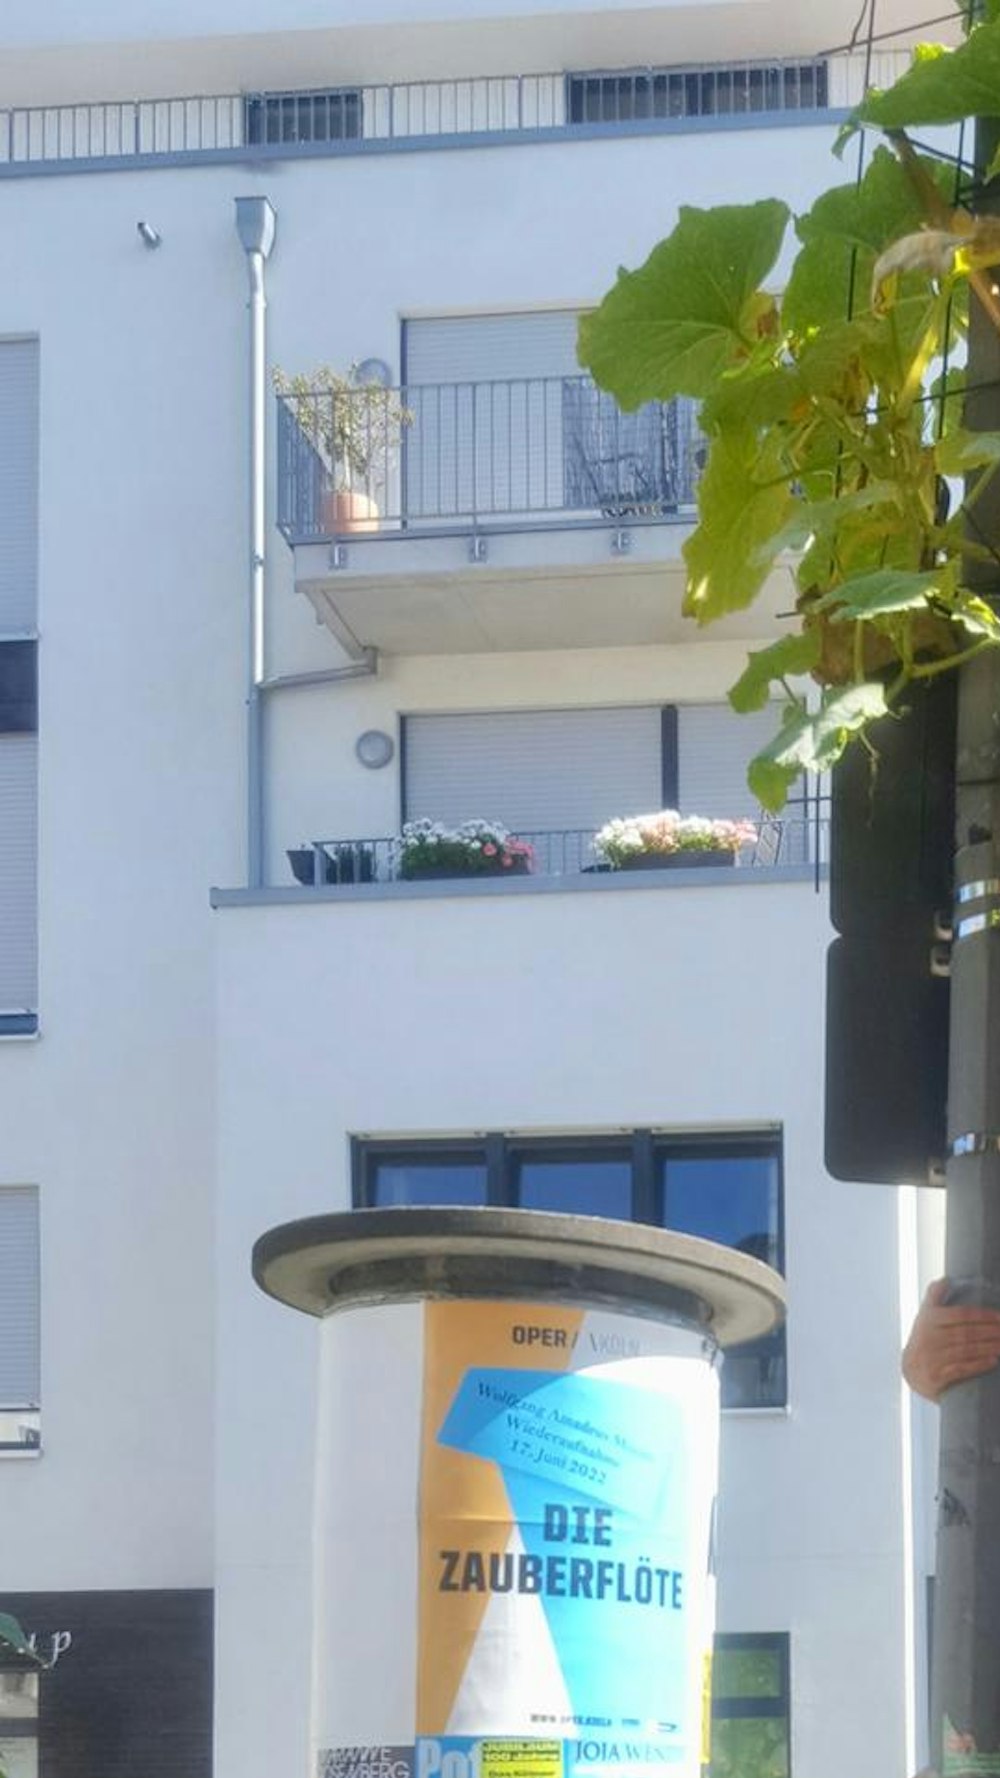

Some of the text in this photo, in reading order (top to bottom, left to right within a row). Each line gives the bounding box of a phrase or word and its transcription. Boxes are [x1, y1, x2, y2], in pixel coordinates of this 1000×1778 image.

[512, 1326, 567, 1347] OPER
[478, 1381, 545, 1419] Wolfgang
[568, 1460, 607, 1486] 2022
[543, 1503, 612, 1547] DIE
[439, 1551, 683, 1609] ZAUBERFLÖTE
